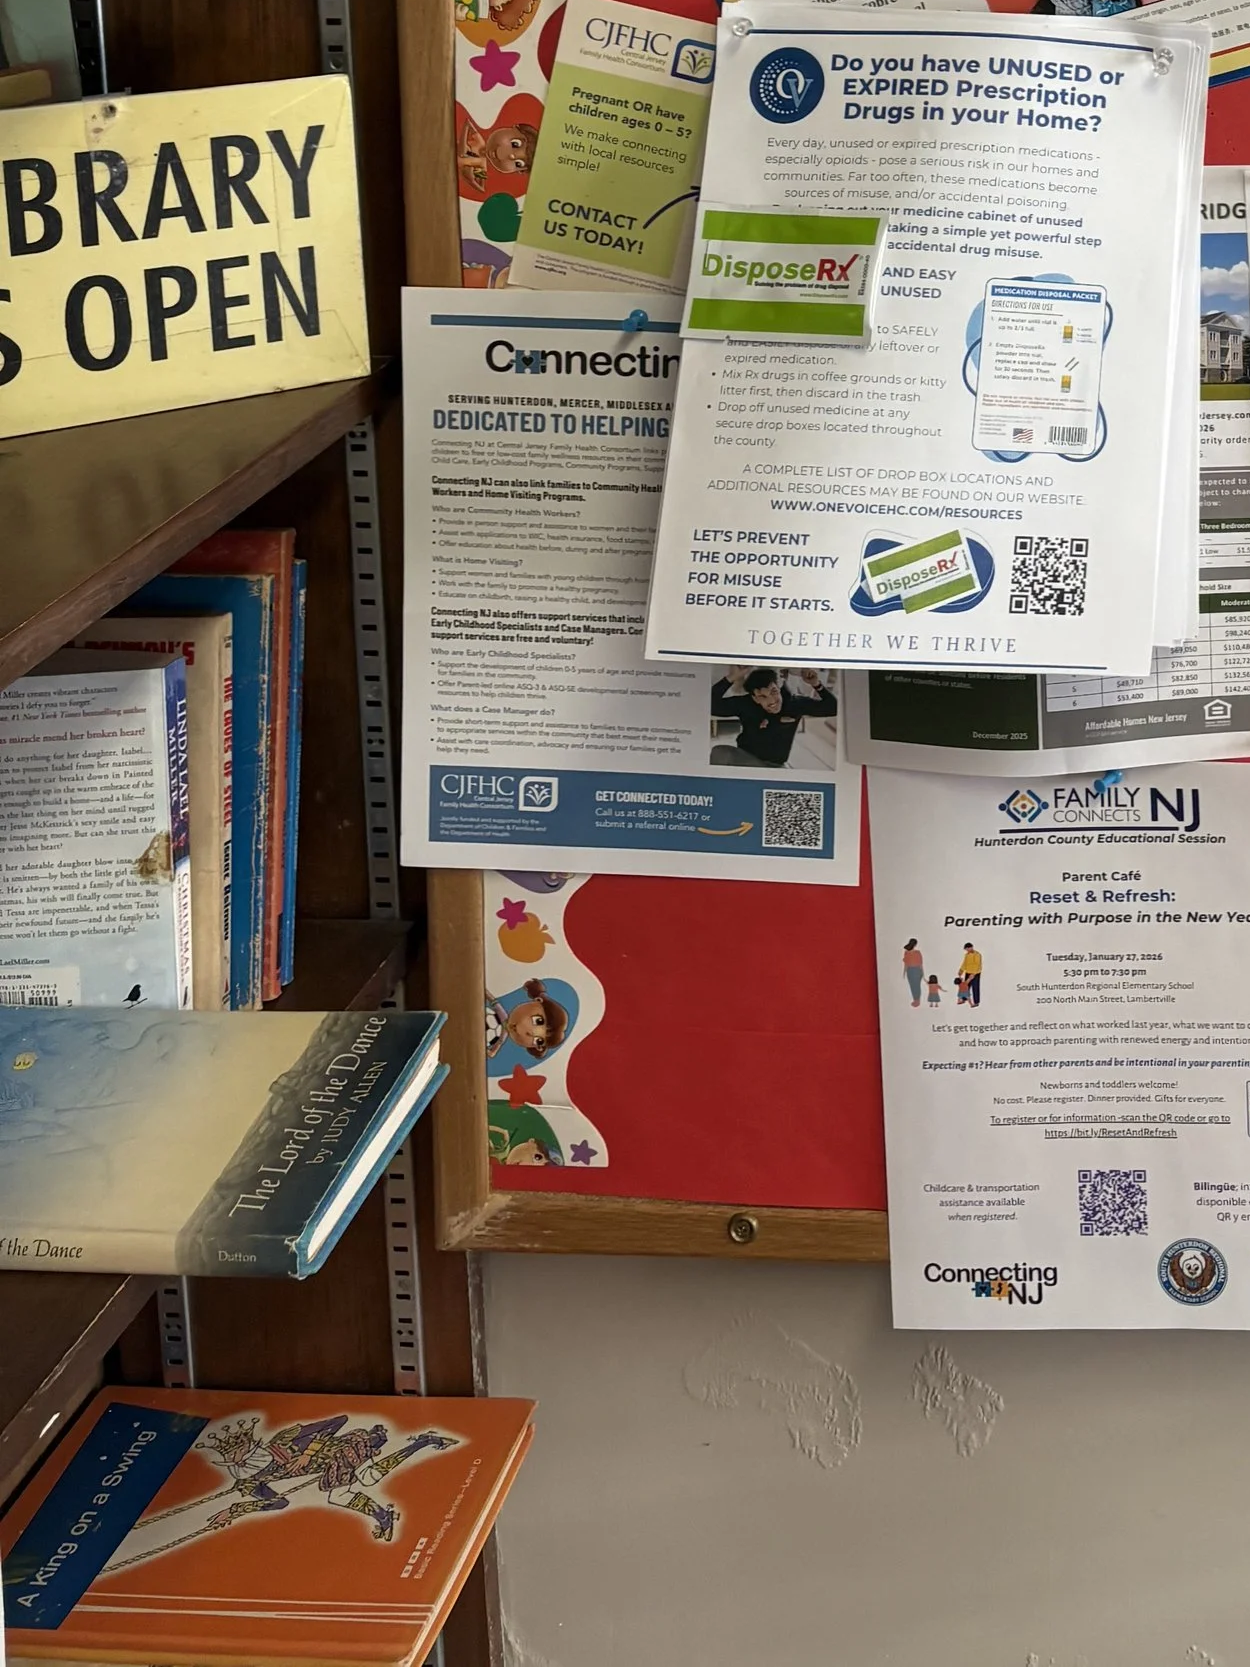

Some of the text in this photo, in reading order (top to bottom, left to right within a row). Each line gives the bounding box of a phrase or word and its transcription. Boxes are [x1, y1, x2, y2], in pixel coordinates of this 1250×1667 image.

[585, 17, 672, 57] CJFHC
[830, 53, 1125, 86] Do you have UNUSED or
[843, 78, 1107, 109] EXPIRED Prescription
[843, 102, 1102, 133] Drugs in your Home?
[2, 124, 326, 258] BRARY
[548, 199, 638, 231] CONTACT
[543, 219, 644, 255] US TODAY!
[702, 254, 859, 285] DisposeRx
[65, 245, 321, 372] OPEN
[433, 409, 670, 439] DEDICATED TO HELPING
[747, 629, 1016, 653] TOGETHER WE THRIVE
[168, 727, 178, 807] MILLER
[177, 699, 190, 820] LINDA LAEL
[440, 774, 515, 799] CJFHC
[595, 790, 713, 807] GET CONNECTED TODAY!
[1054, 787, 1140, 808] FAMILY
[1053, 808, 1141, 823] CONNECTS
[1150, 788, 1200, 832] NJ
[974, 833, 1226, 847] Hunterdon County Educational Session
[1062, 870, 1142, 882] Parent Café
[1030, 888, 1176, 904] Reset & Refresh:
[228, 1015, 387, 1217] The Lord of the Dance
[6, 1237, 84, 1259] the Dance
[924, 1262, 1058, 1287] Connecting
[1008, 1282, 1043, 1305] NJ
[16, 1430, 158, 1608] A King on a Swing
